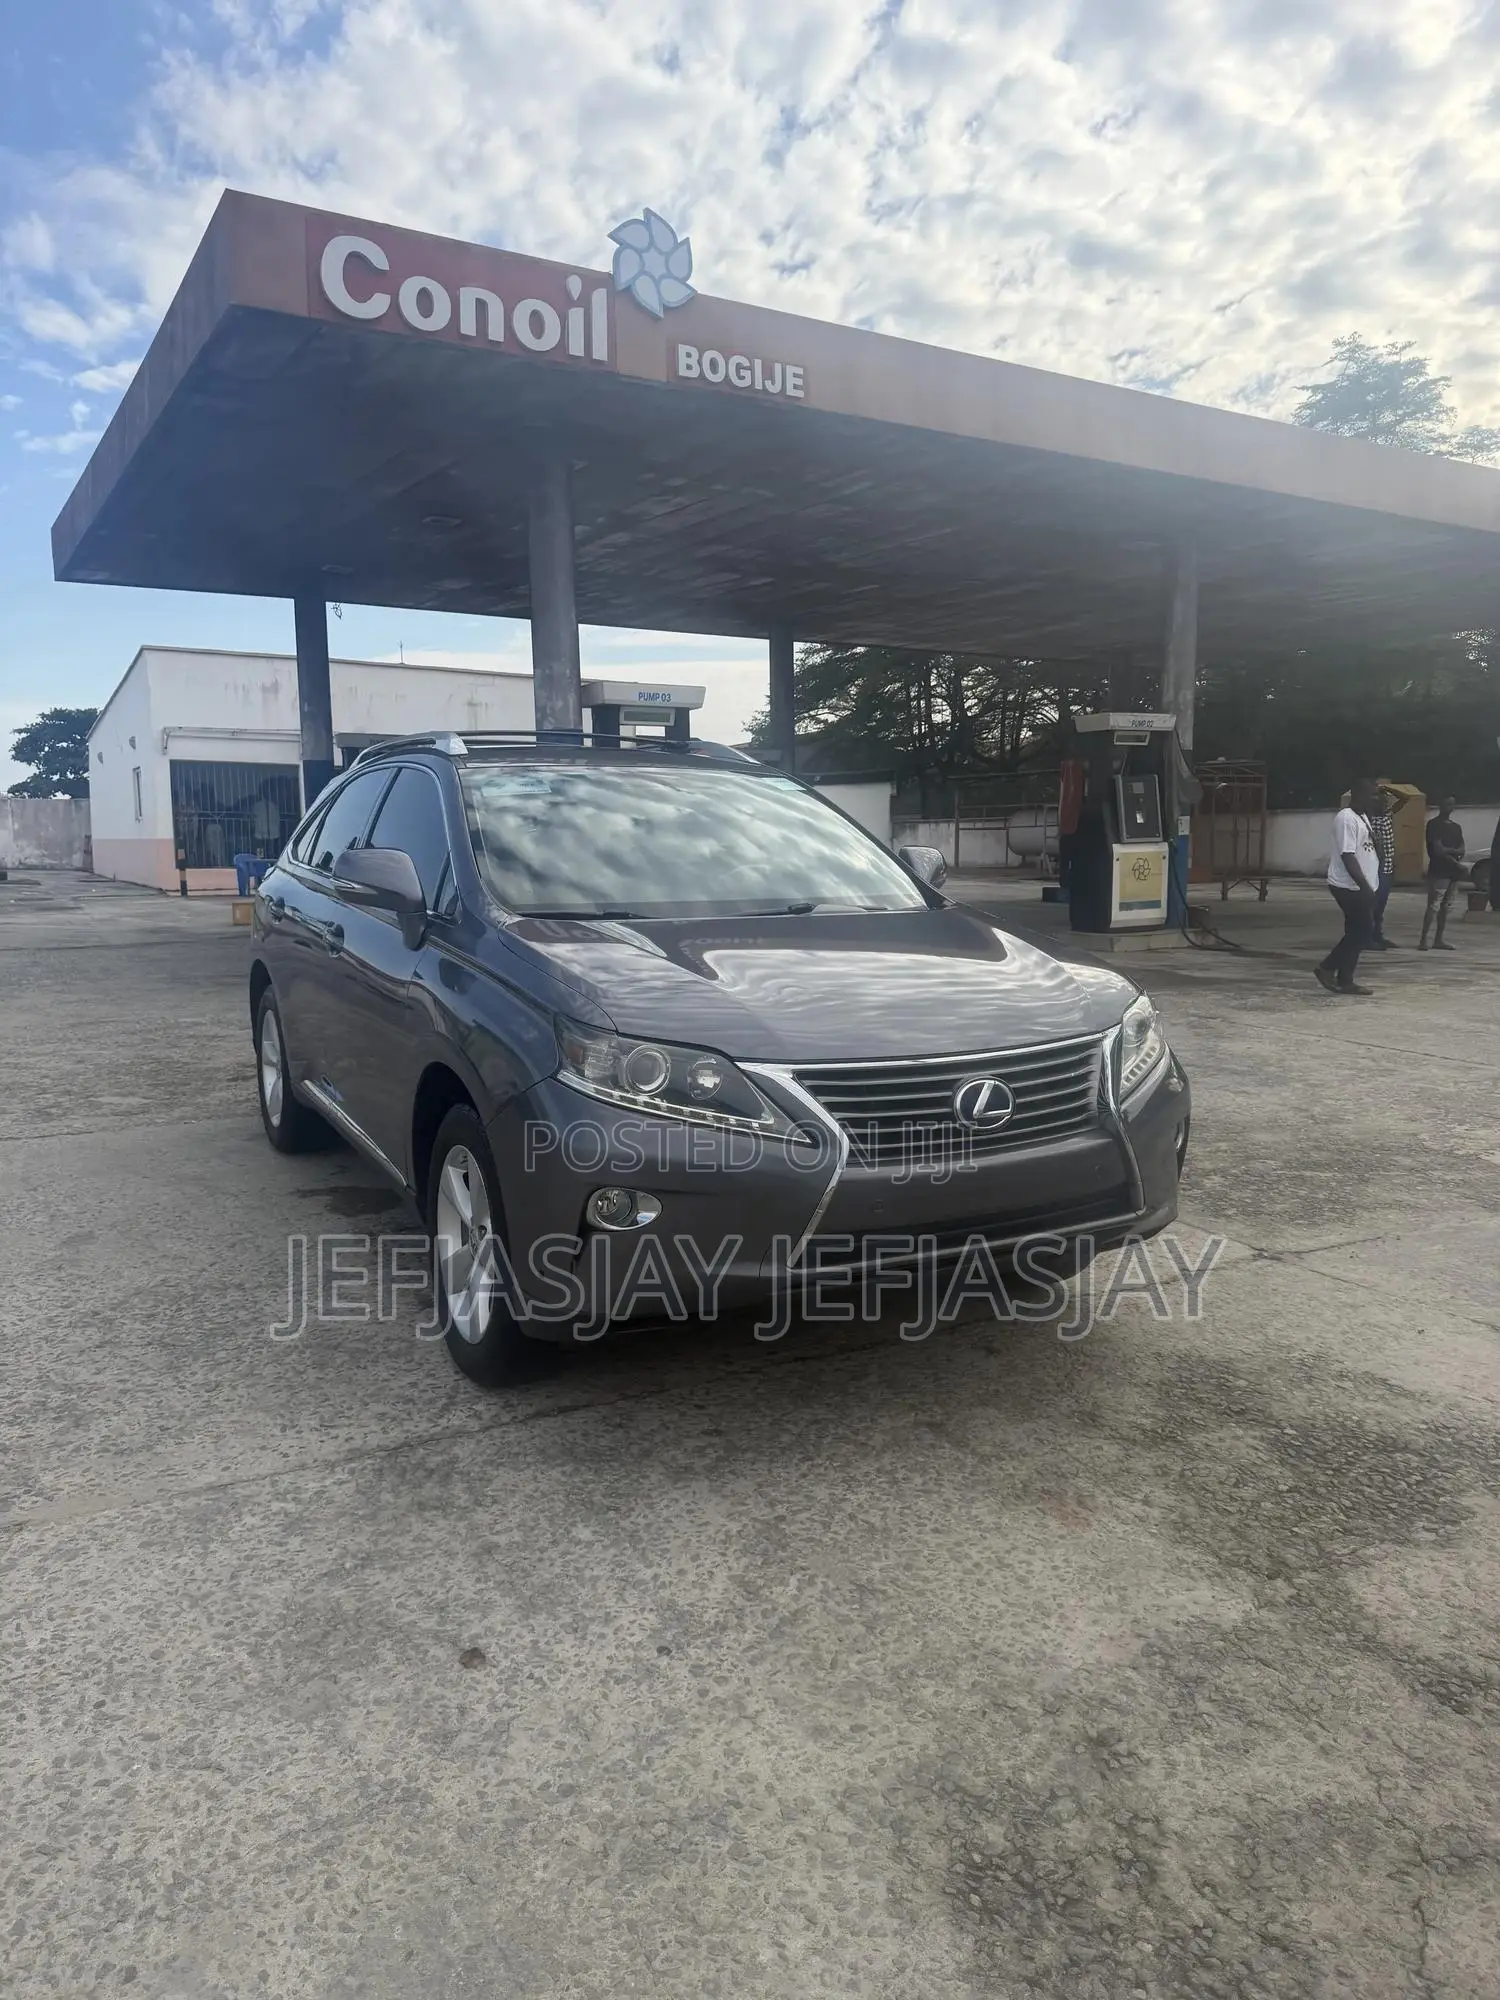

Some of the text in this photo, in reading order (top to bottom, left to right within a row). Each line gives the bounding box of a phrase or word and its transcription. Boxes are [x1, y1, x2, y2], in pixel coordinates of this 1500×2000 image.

[319, 234, 609, 363] Conoil
[676, 342, 805, 398] BOGIJE
[638, 691, 671, 703] PUMP 03
